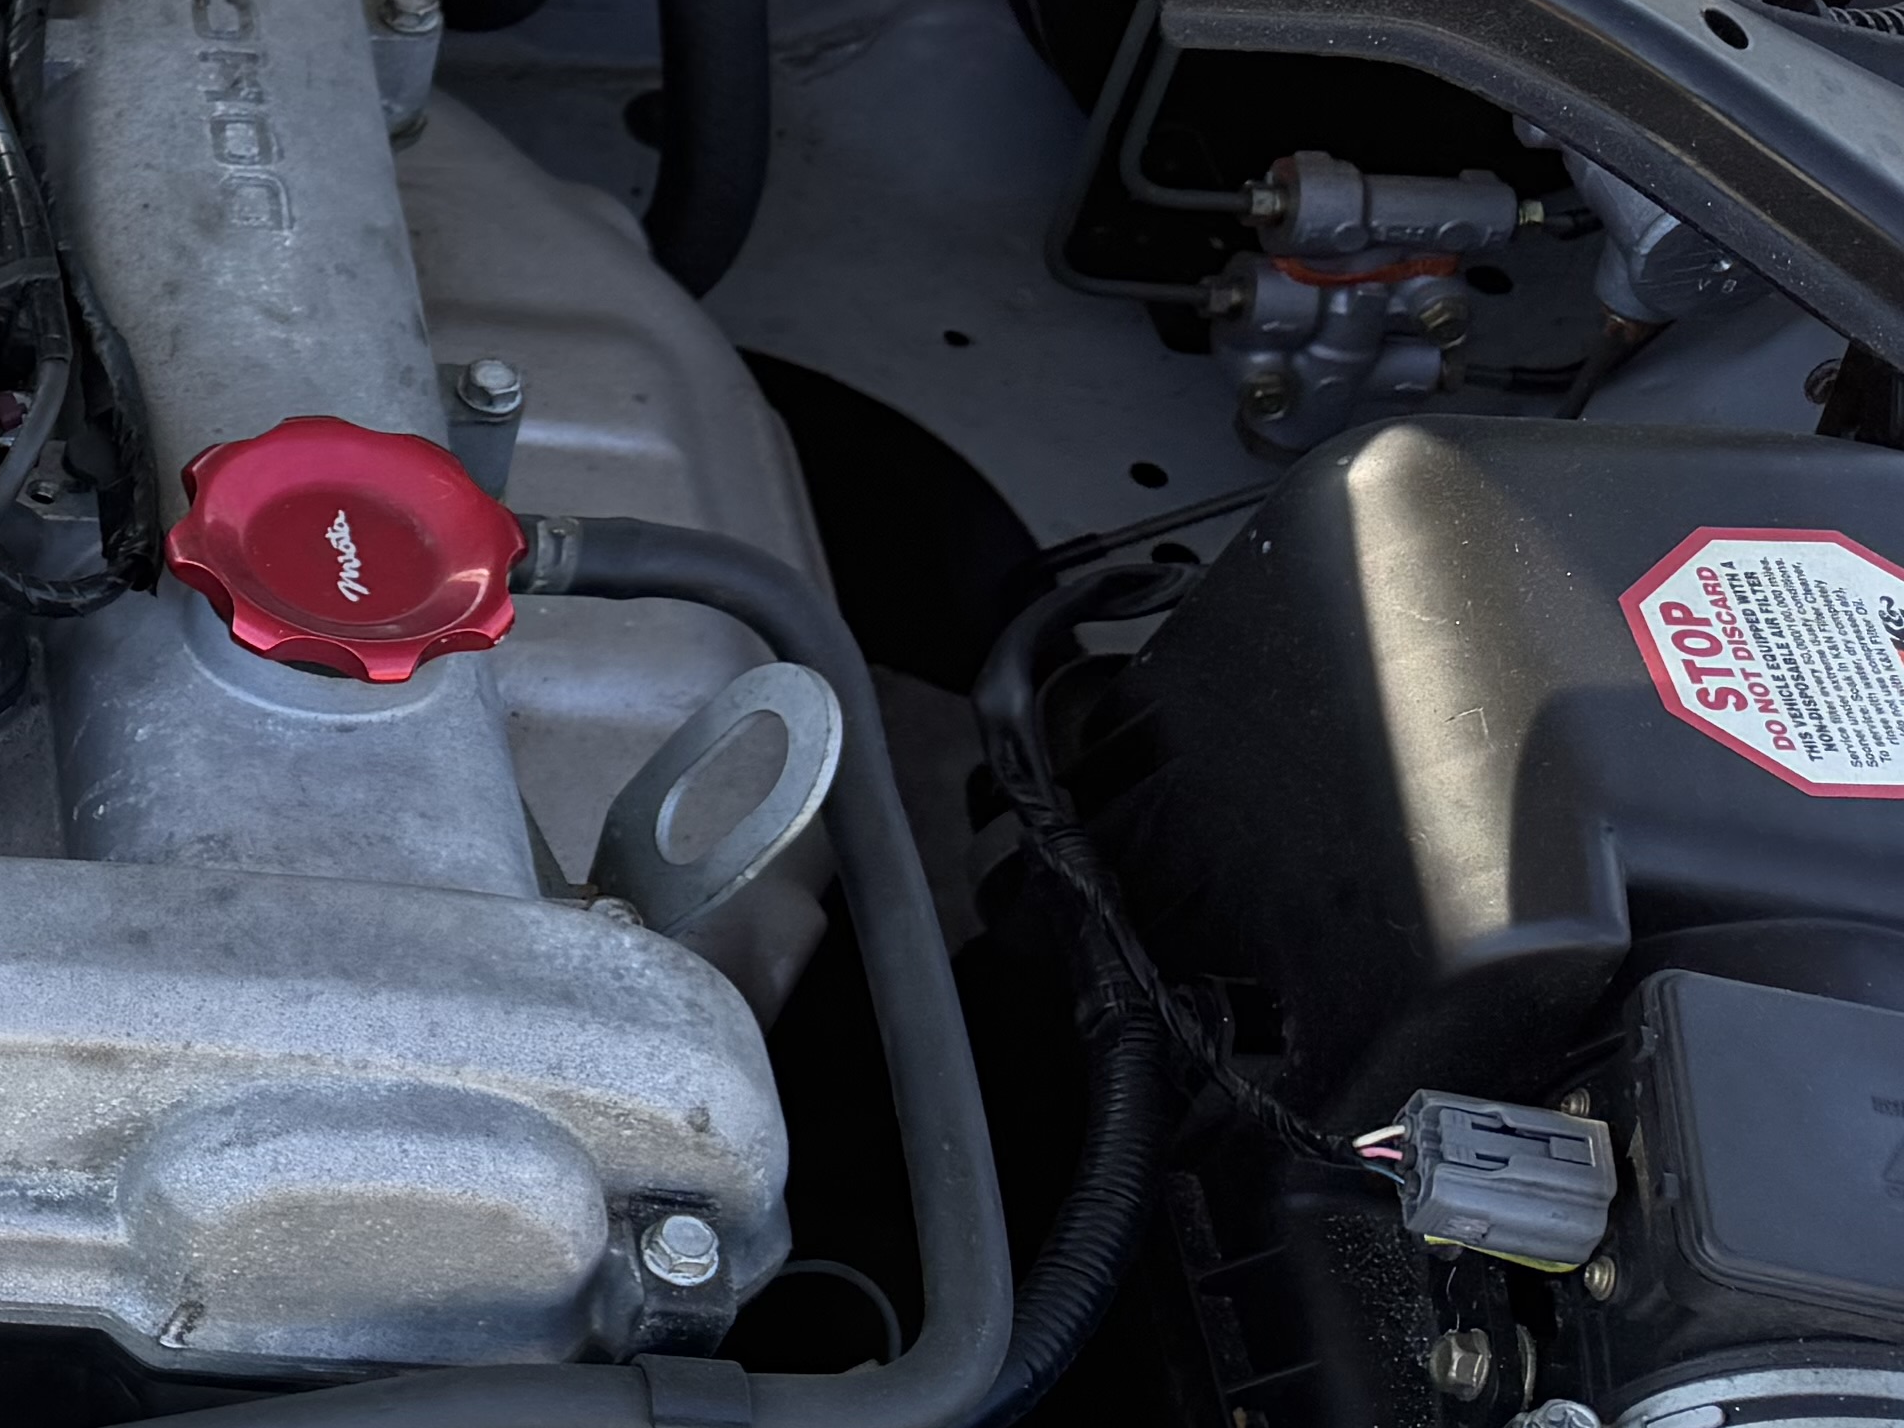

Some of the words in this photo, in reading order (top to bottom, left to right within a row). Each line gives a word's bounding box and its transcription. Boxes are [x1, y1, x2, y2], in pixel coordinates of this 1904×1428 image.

[1724, 572, 1750, 605] WITH
[1743, 571, 1773, 614] FILTER
[1696, 566, 1753, 660] DISCARD
[1764, 616, 1785, 638] AIR
[1660, 601, 1747, 710] STOP
[1741, 608, 1780, 670] EQUIPPED
[1739, 667, 1779, 714] NOT
[1815, 648, 1842, 692] extreme
[1770, 673, 1806, 727] VEHICLE
[1775, 642, 1837, 751] NON-DISPOSABLE
[1836, 694, 1859, 726] under
[1764, 719, 1796, 750] DO
[1797, 731, 1823, 761] THIS
[1837, 726, 1863, 767] Service
[1852, 728, 1878, 767] Sooner
